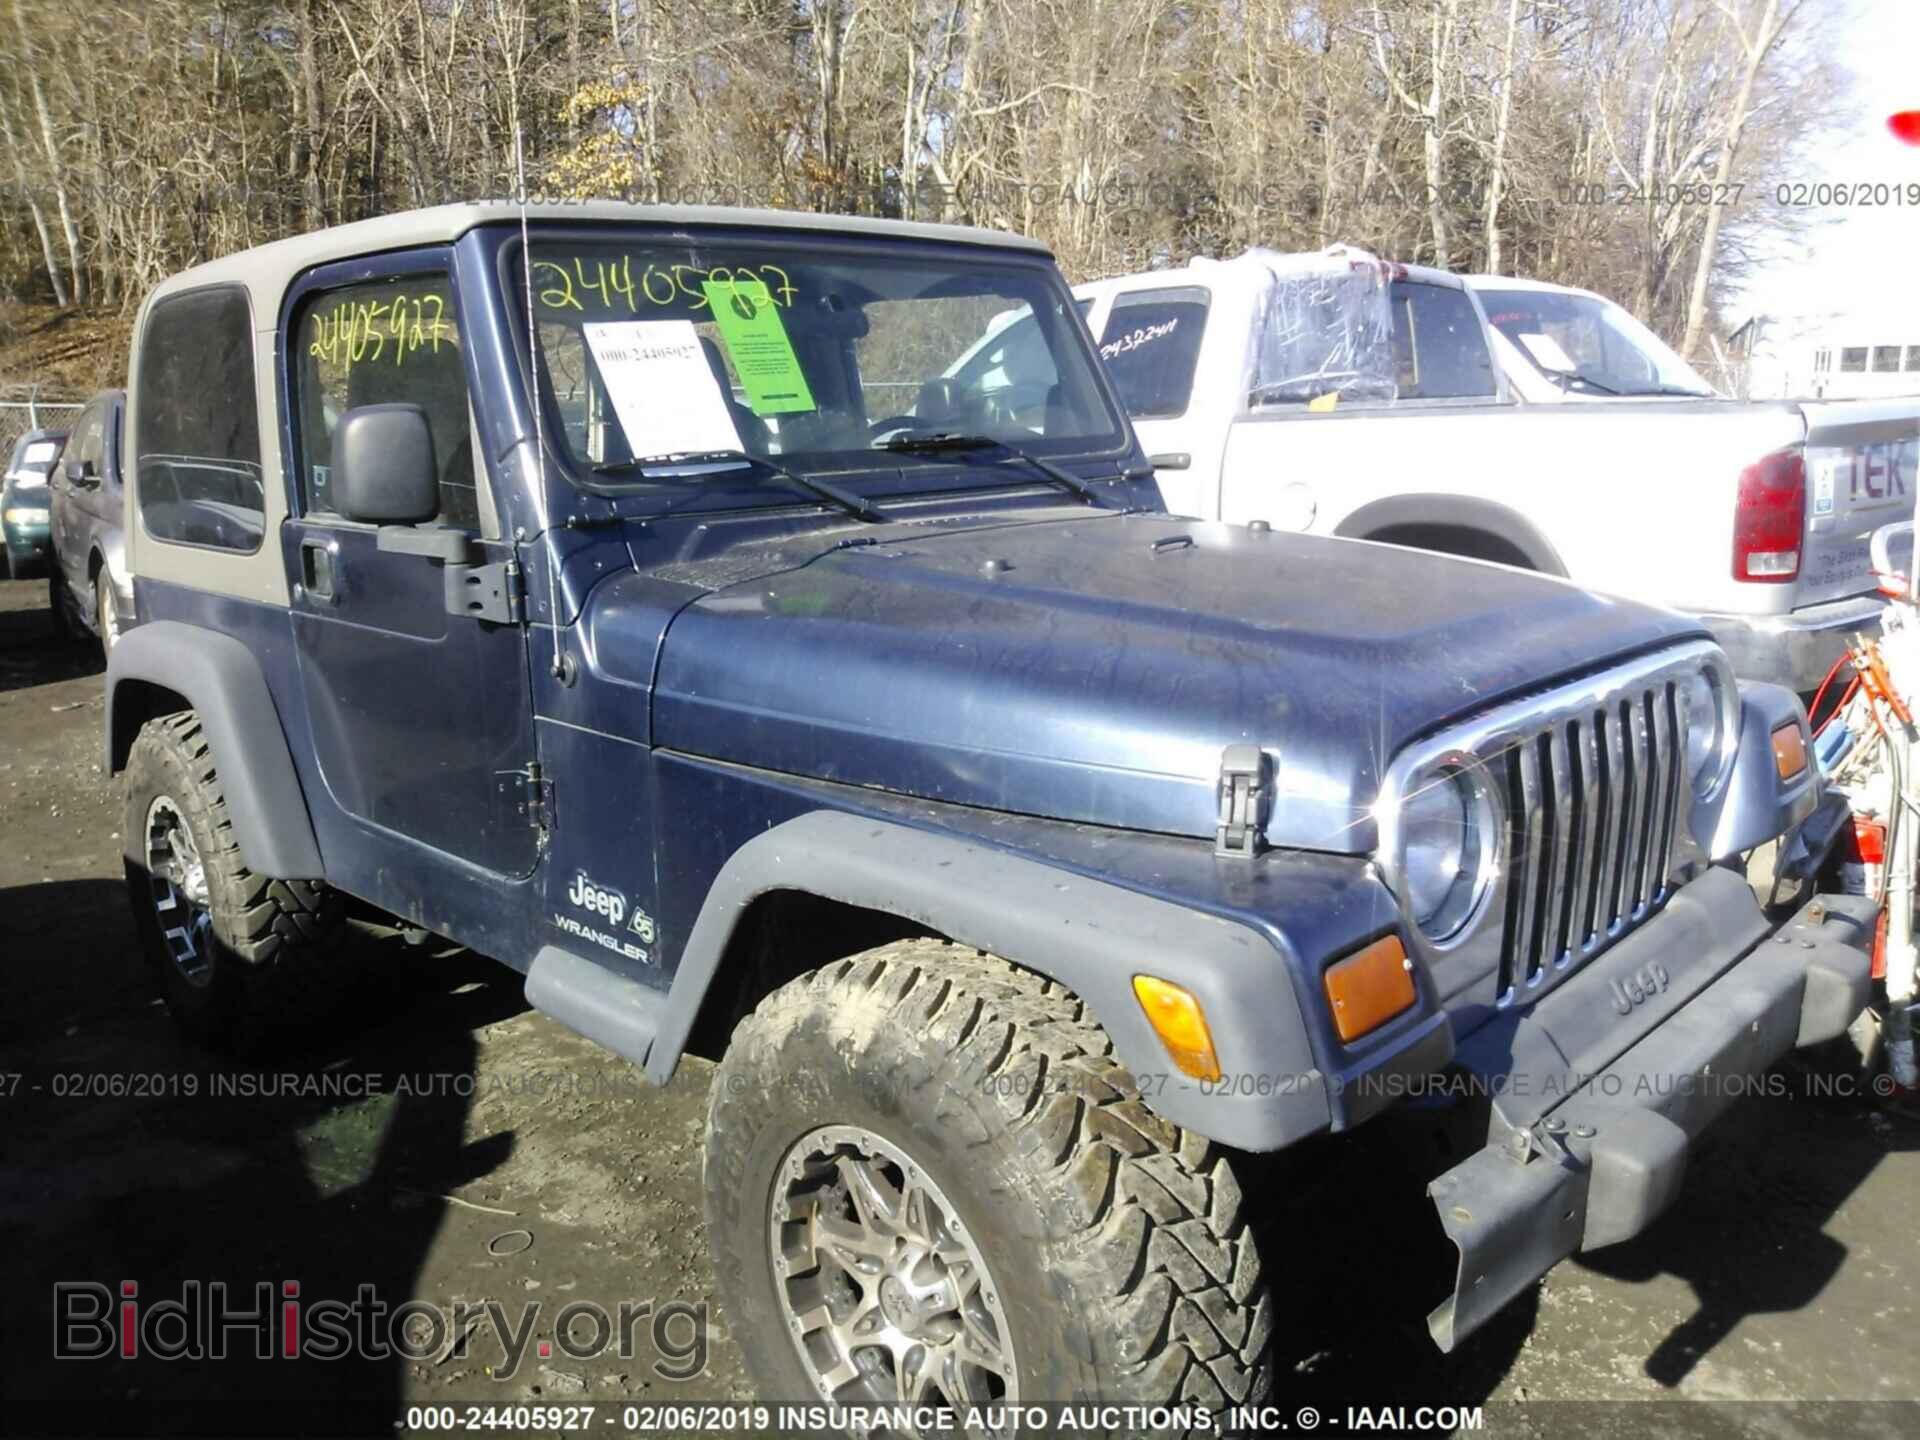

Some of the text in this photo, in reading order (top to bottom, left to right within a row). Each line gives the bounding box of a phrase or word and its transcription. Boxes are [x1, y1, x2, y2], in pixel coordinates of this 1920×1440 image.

[534, 255, 799, 313] 24405927
[310, 295, 449, 374] 24405927
[568, 874, 625, 926] Jeep
[554, 913, 649, 964] WRANGLER
[1609, 961, 1669, 1016] Jeep
